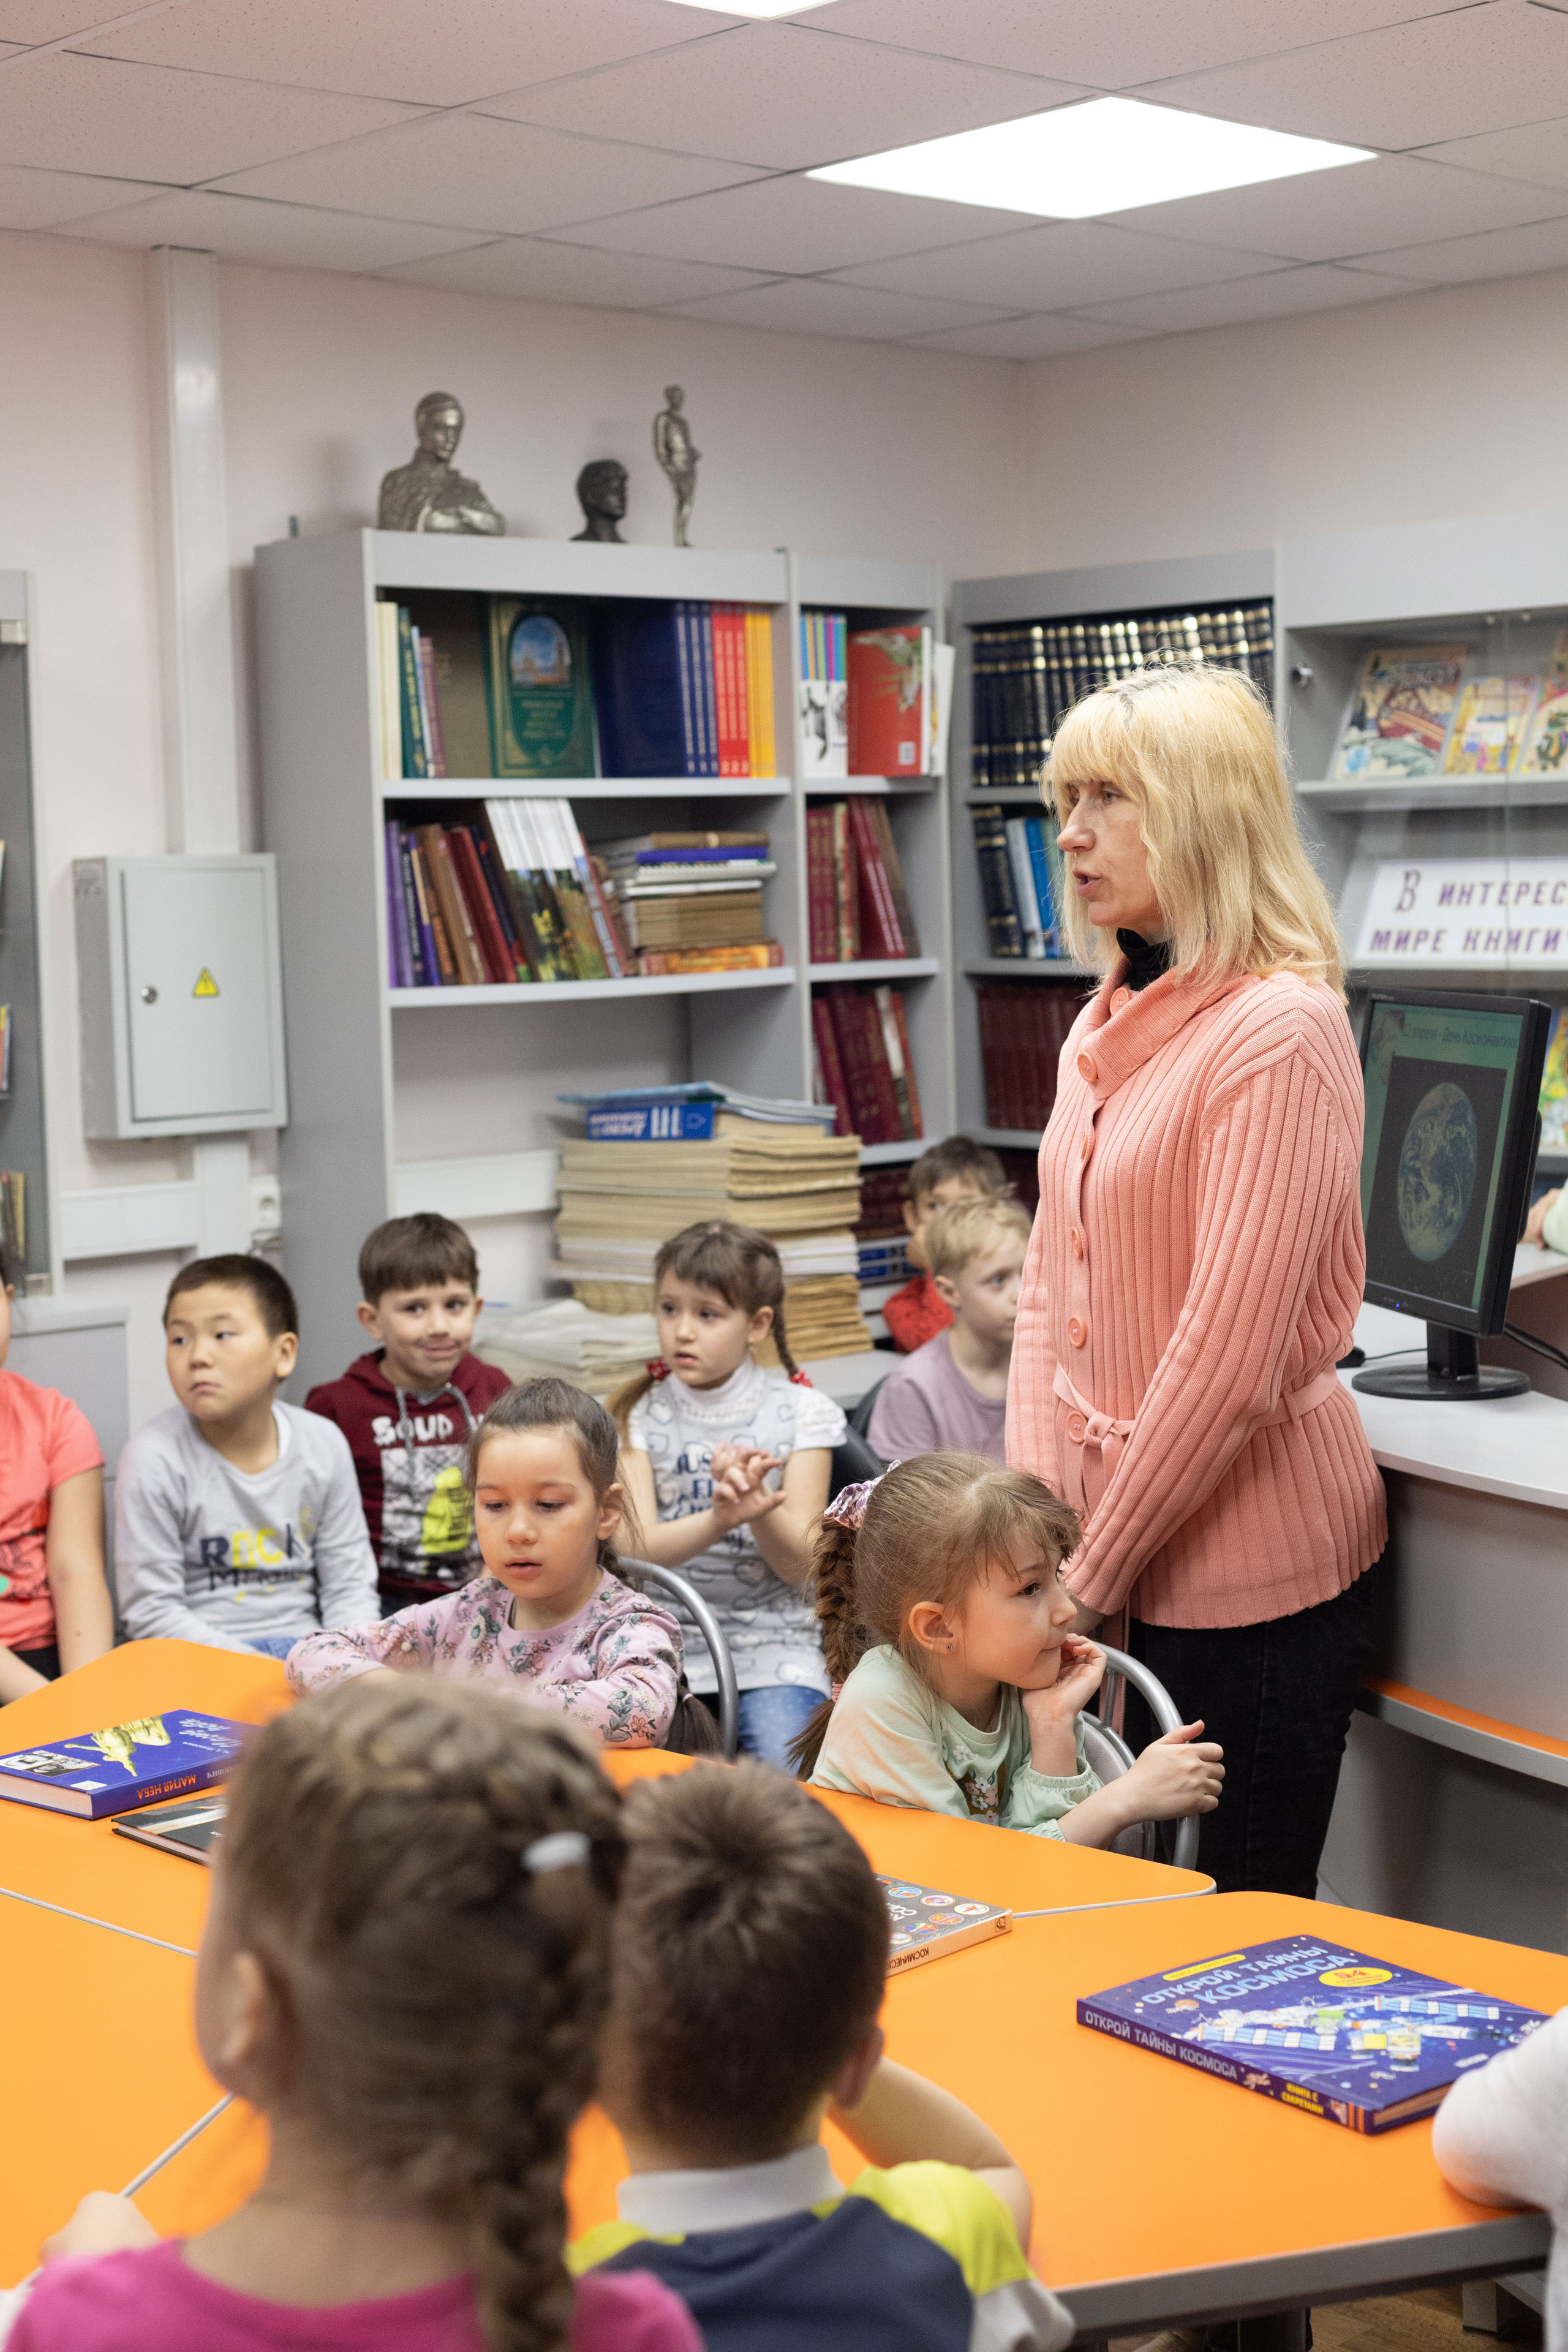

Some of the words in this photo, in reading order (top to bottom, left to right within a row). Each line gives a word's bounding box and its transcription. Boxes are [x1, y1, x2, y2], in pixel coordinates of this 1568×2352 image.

[1395, 869, 1421, 912] В
[1438, 881, 1567, 905] ИНТЕРЕС
[1370, 928, 1447, 952] МИРЕ
[1463, 928, 1561, 952] КНИГИ
[137, 1783, 162, 1800] НЕБА
[164, 1774, 196, 1792] МАГИЯ
[888, 1948, 929, 1969] КОСМИЧЕСК
[1142, 1969, 1242, 2003] ОТКРОЙ
[1238, 1946, 1329, 1972] ТАЙНЫ
[1193, 1954, 1358, 2004] КОСМОСА
[1085, 2011, 1131, 2038] ОТКРОЙ
[1134, 2028, 1176, 2056] ТАЙНЫ
[1180, 2046, 1238, 2079] КОСМОСА
